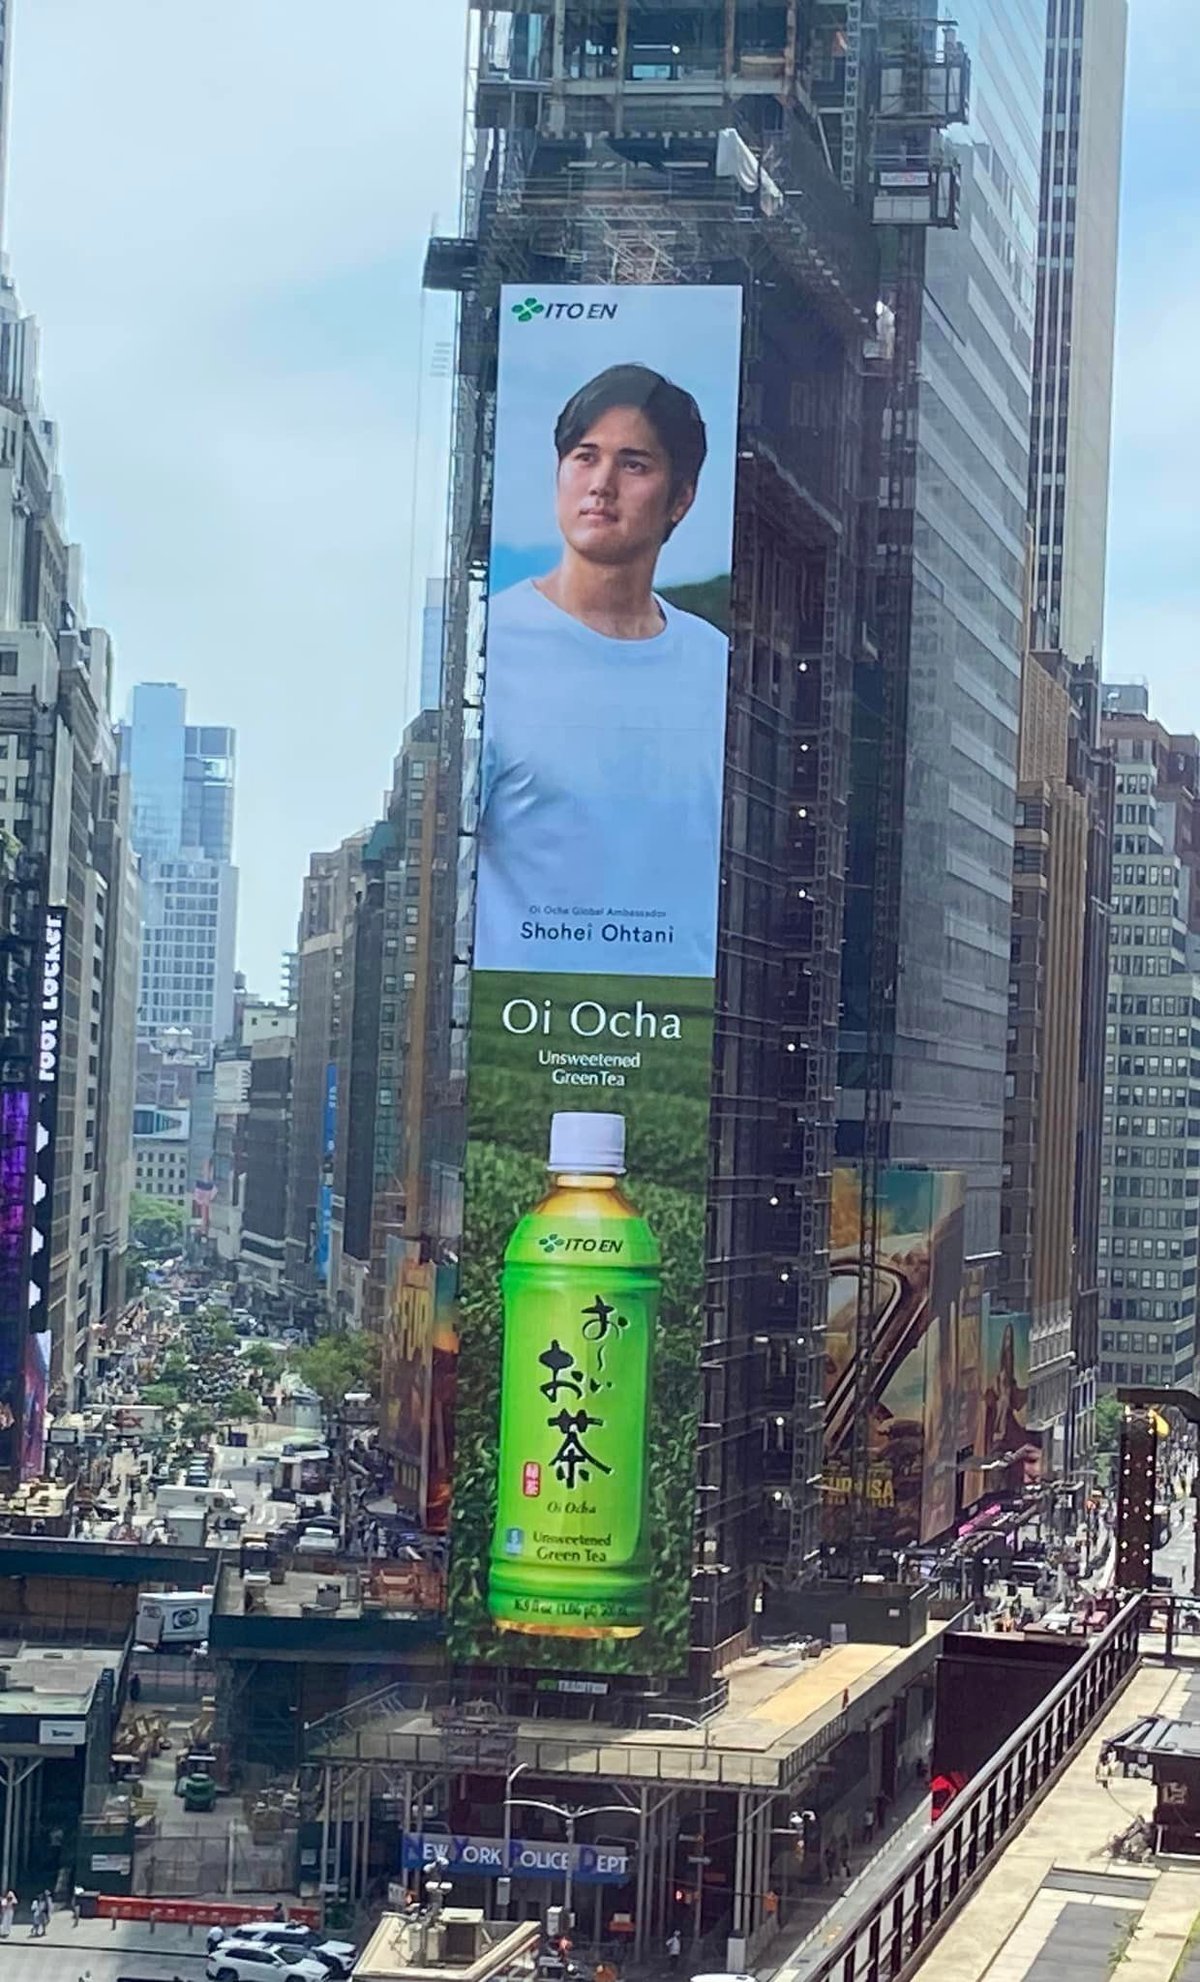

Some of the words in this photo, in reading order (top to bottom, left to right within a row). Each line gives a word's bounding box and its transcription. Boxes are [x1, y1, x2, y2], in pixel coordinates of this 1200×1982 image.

[545, 302, 585, 320] ITO
[586, 303, 619, 320] EN
[520, 921, 593, 942] Shohei
[601, 923, 674, 944] Ohtani
[501, 998, 552, 1035] Oi
[570, 1000, 682, 1040] Ocha
[538, 1050, 641, 1069] Unsweetened
[552, 1069, 600, 1087] Green
[599, 1071, 626, 1088] Tea
[564, 1237, 597, 1253] ITO
[599, 1239, 624, 1254] EN
[532, 1531, 613, 1547] Unsweetened
[536, 1546, 581, 1561] Green
[585, 1549, 607, 1563] Tea
[402, 1834, 450, 1867] NEW
[452, 1836, 502, 1866] YORK
[509, 1840, 568, 1871] POLICE
[579, 1845, 629, 1875] DEPT
